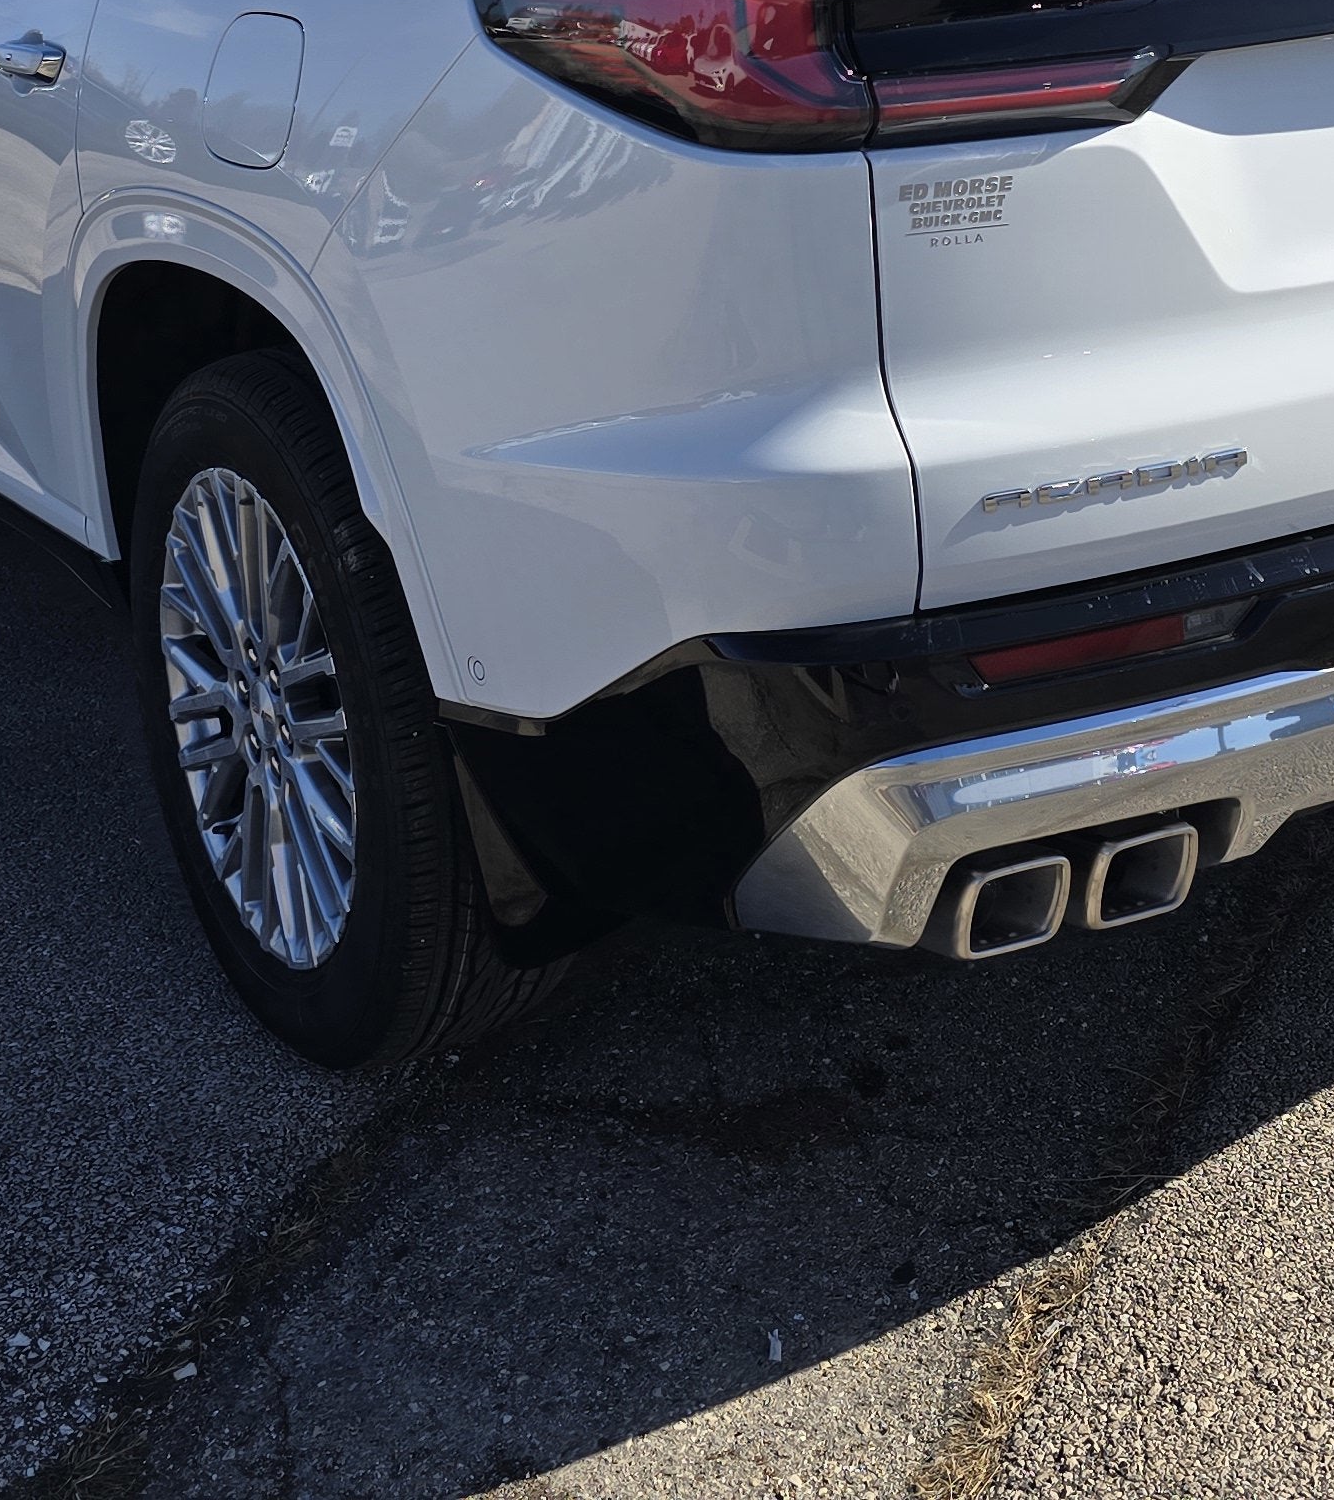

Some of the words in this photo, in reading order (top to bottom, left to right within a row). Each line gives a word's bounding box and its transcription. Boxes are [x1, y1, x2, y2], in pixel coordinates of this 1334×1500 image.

[898, 183, 929, 202] ED
[933, 175, 1013, 199] MORSE
[908, 194, 1006, 216] CHEVROLET
[929, 233, 984, 248] ROLLA
[982, 446, 1249, 513] ACADIA
